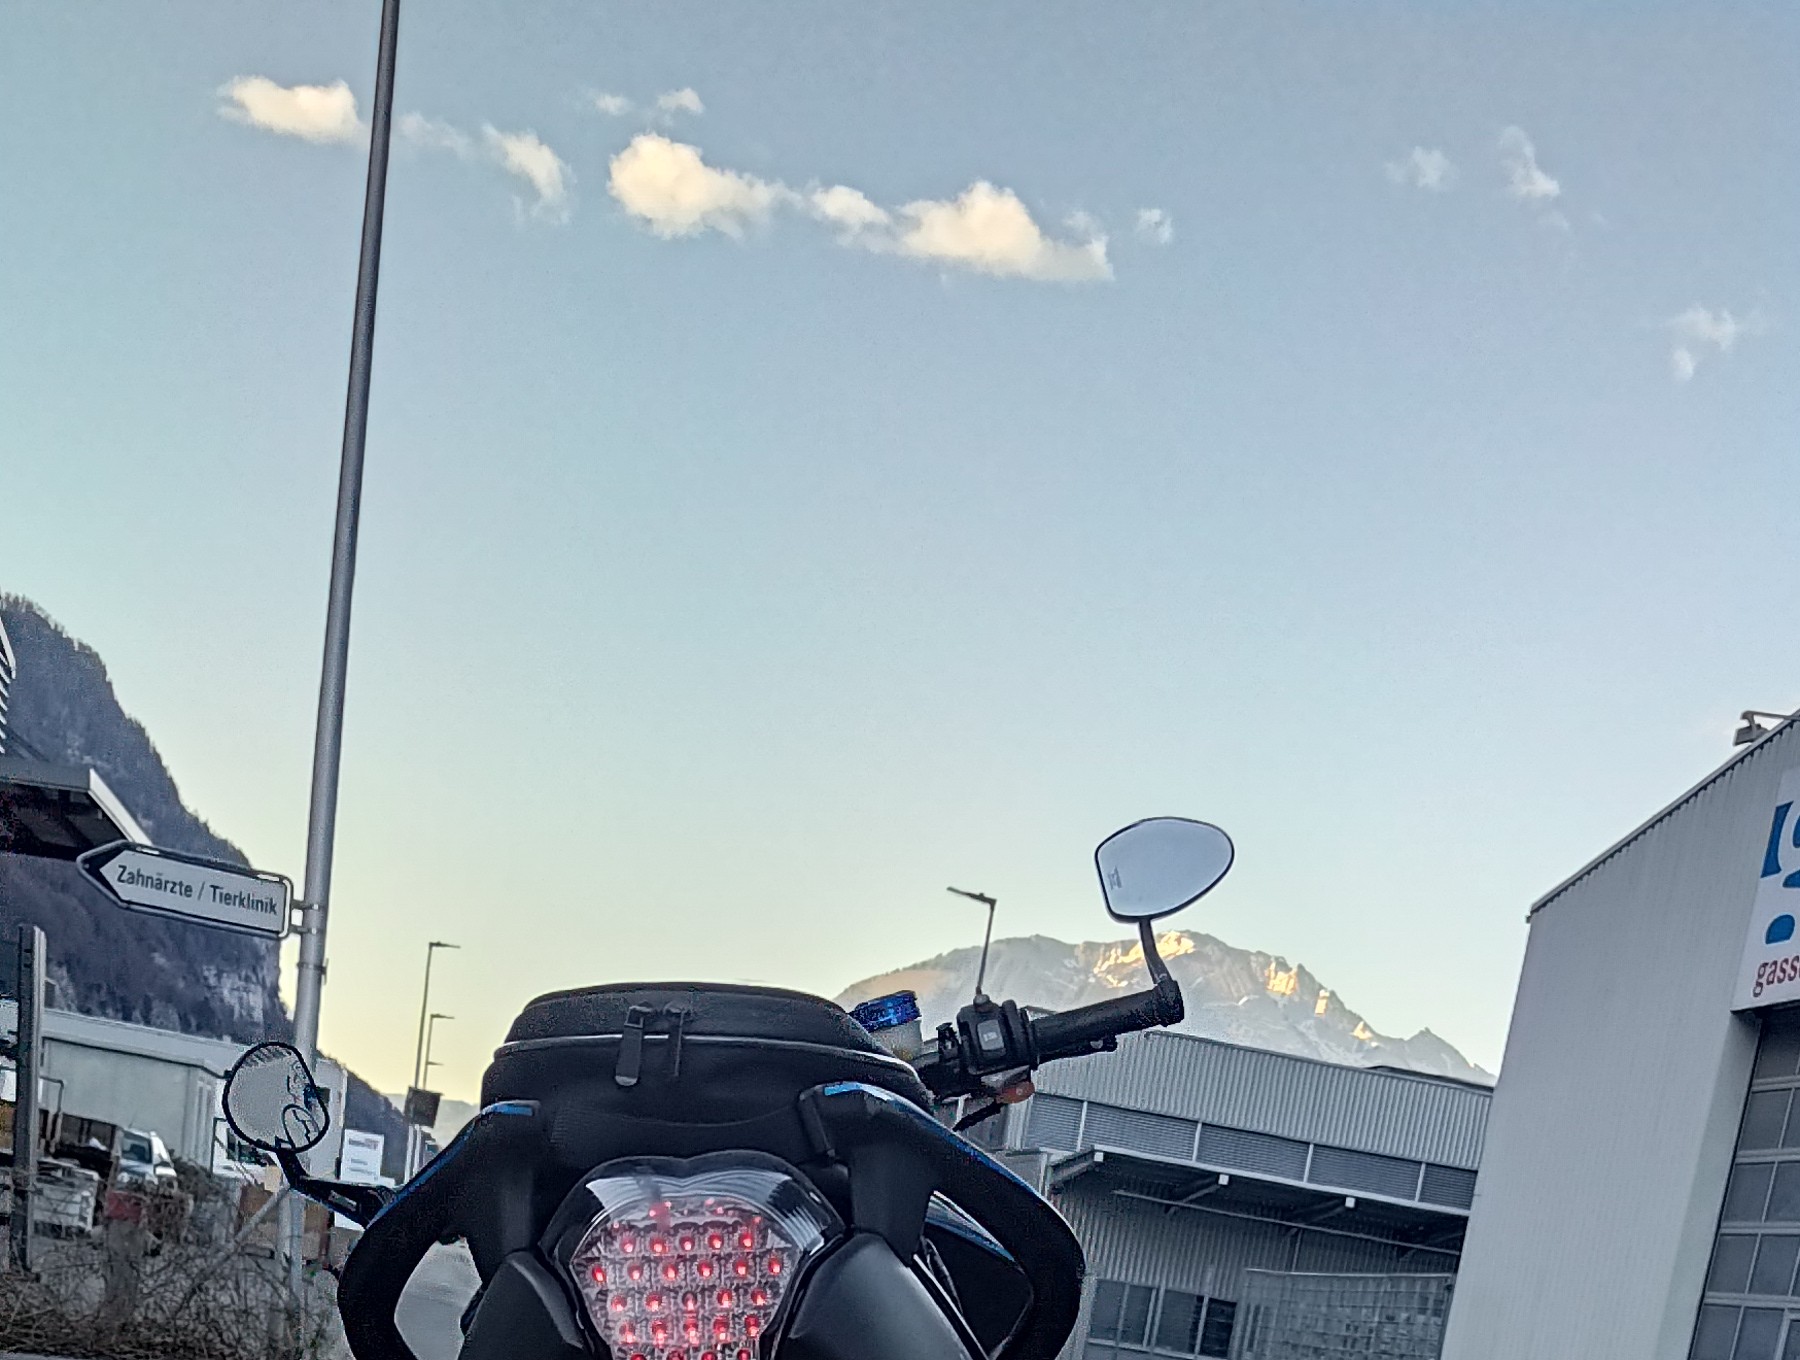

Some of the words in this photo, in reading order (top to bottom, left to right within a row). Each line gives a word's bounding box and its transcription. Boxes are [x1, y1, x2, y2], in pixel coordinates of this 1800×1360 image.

[116, 864, 194, 899] Zahnärzte
[197, 881, 206, 901] /
[209, 884, 278, 916] Tierklinik
[1752, 954, 1800, 998] gass
